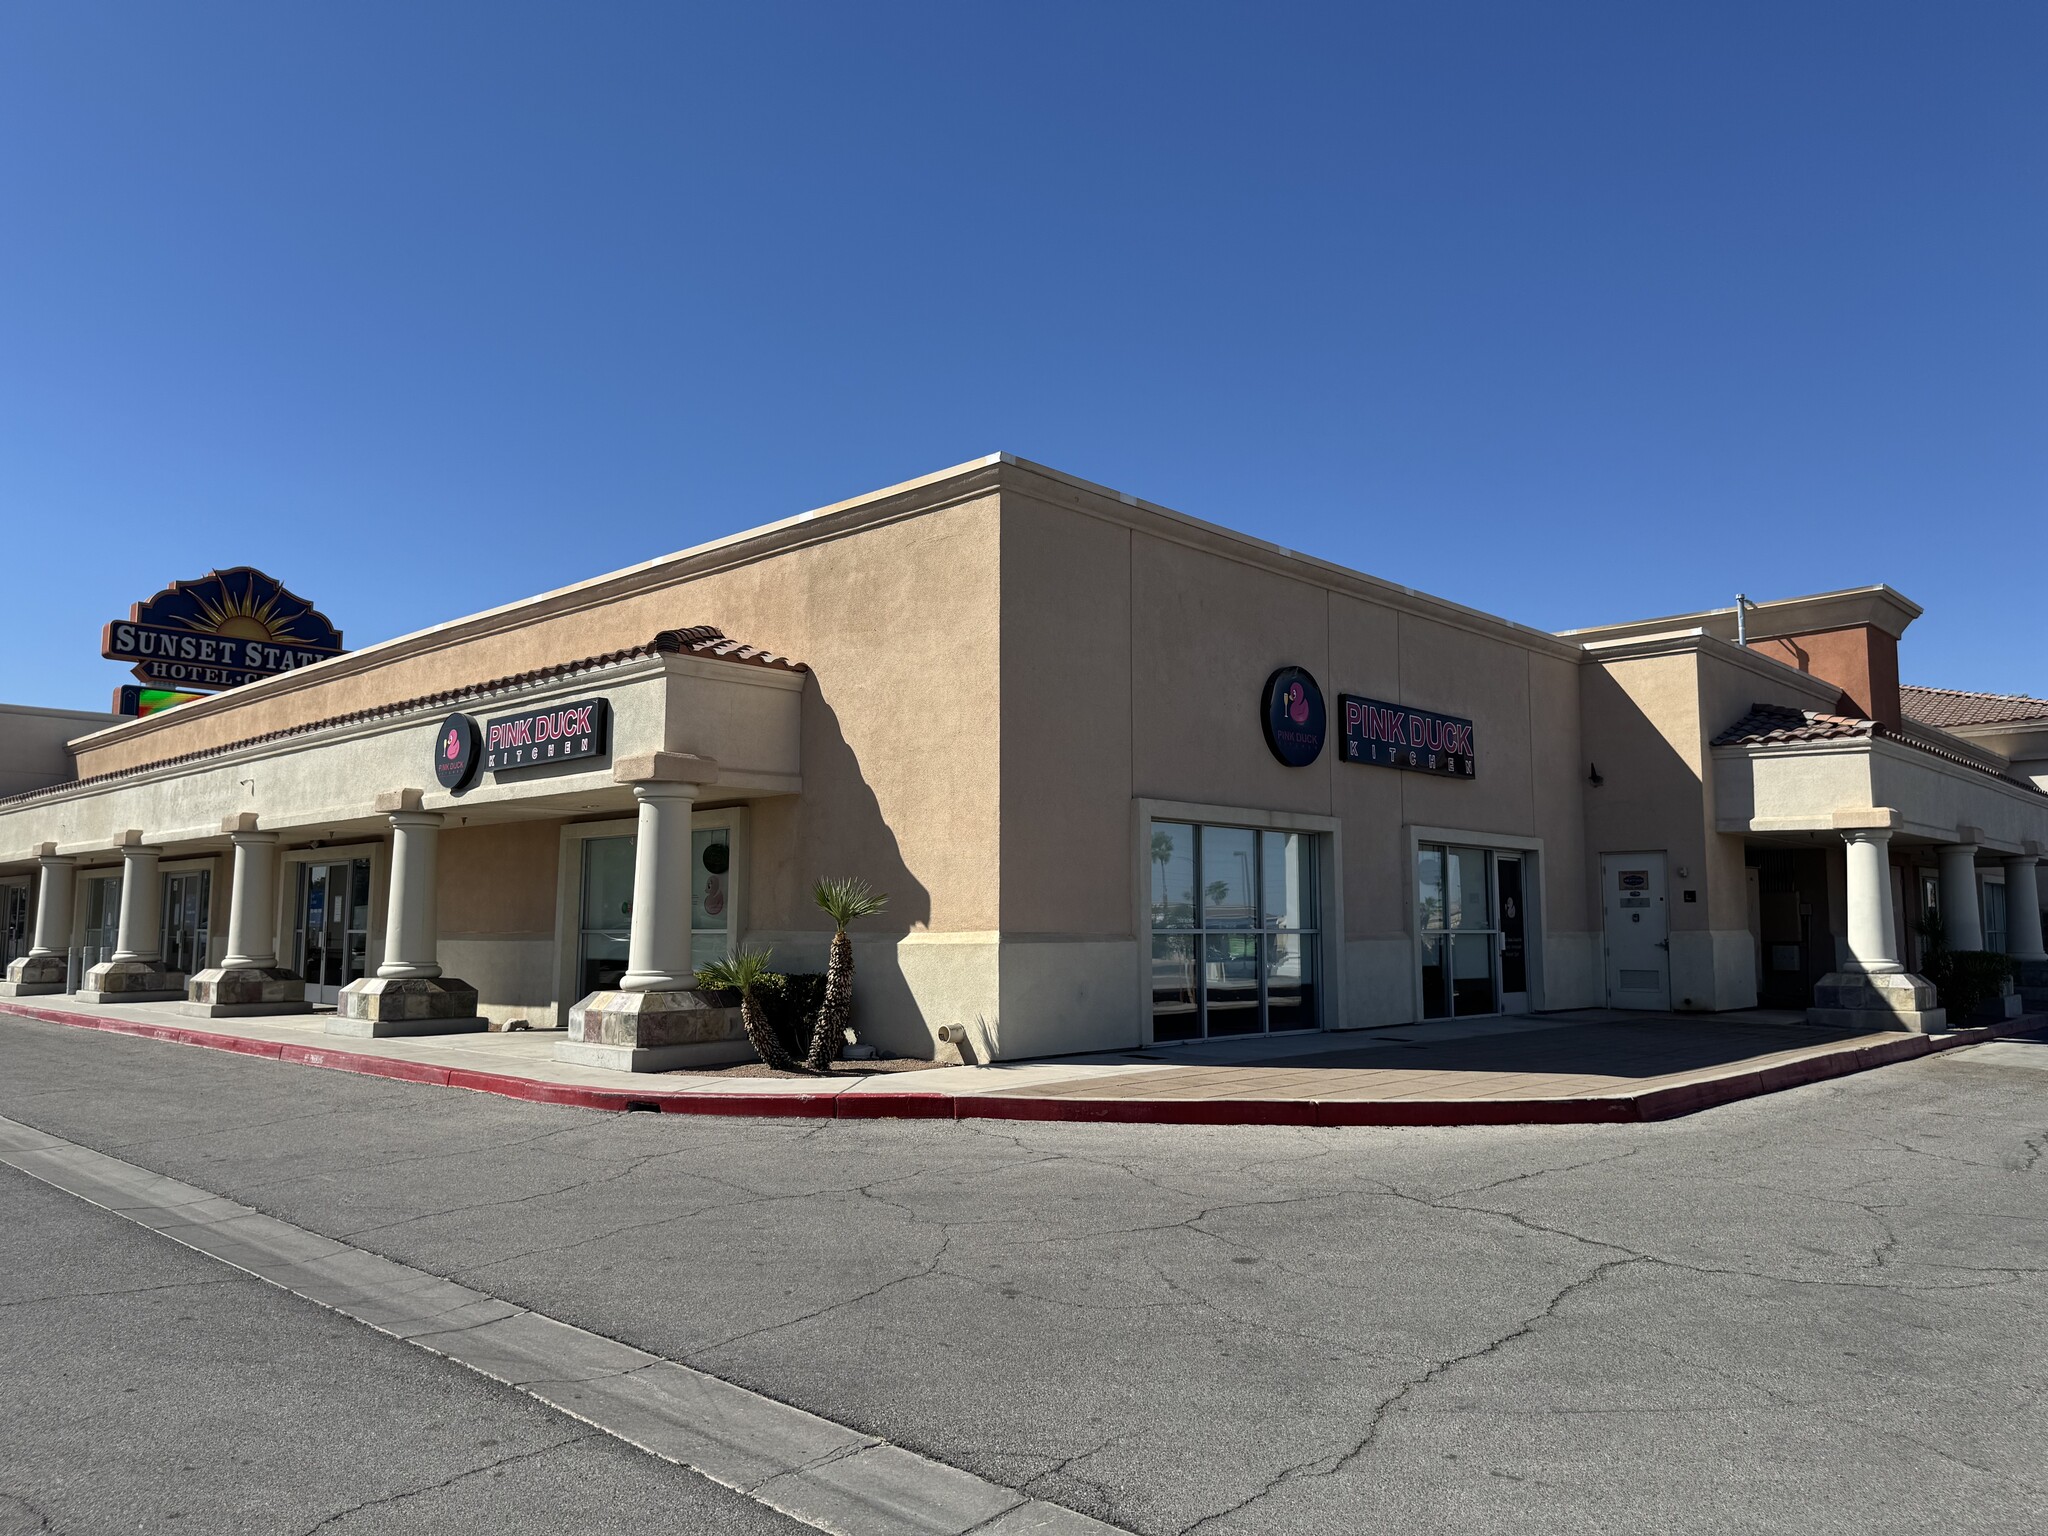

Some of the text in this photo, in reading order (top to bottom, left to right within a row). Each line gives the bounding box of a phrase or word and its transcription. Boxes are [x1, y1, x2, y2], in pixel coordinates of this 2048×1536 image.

[116, 625, 336, 671] SUNSET STAT
[151, 662, 233, 684] HOTEL
[489, 705, 593, 752] PINK DUCK
[1277, 730, 1318, 744] PINK DUCK
[1346, 700, 1474, 756] PINK DUCK
[488, 738, 589, 767] KITCHEN
[1349, 740, 1473, 775] KITCHEN
